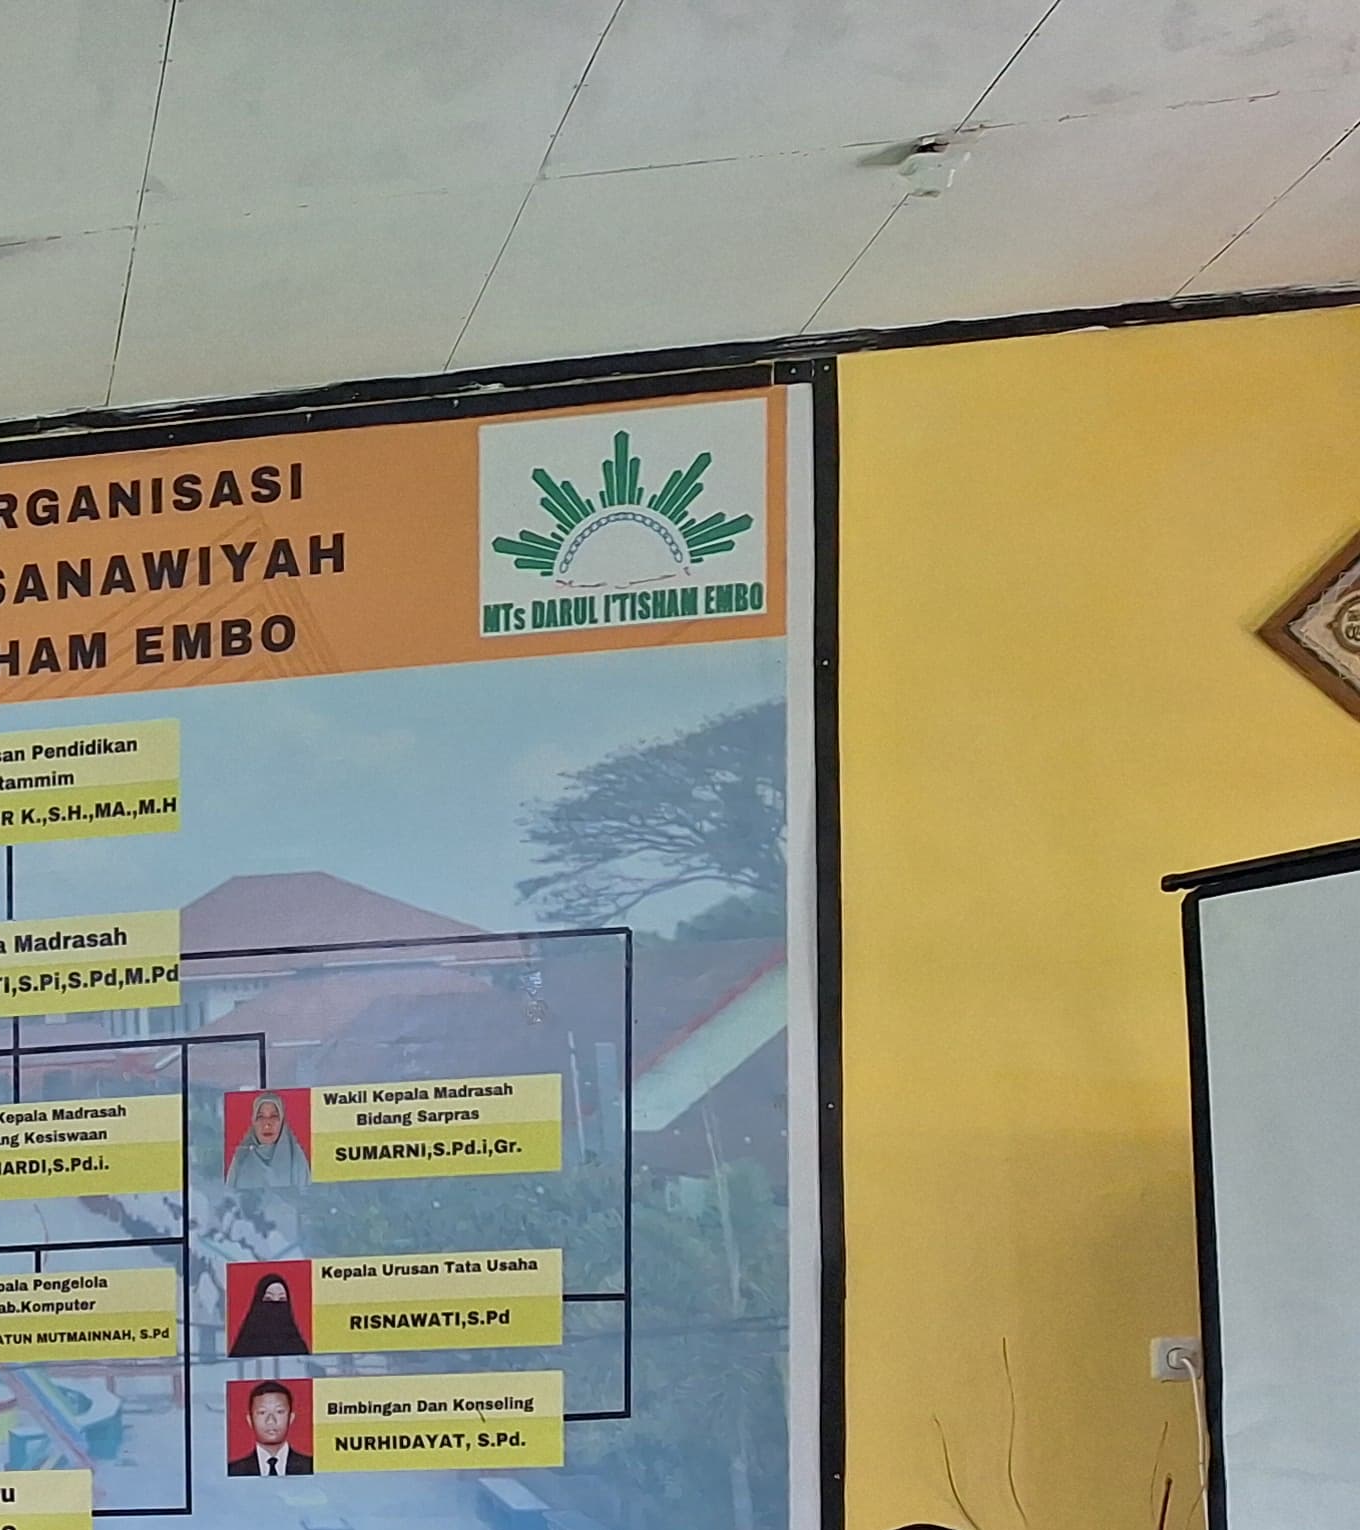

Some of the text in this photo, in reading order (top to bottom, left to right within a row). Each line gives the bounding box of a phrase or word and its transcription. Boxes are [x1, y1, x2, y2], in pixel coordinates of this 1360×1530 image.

[483, 581, 765, 633] MTs DARUL I'TISHAM EMBO
[135, 614, 296, 665] EMBO
[31, 738, 138, 760] Pendidikan
[14, 926, 127, 954] Madrasah
[323, 1082, 514, 1106] Wakil Kepala Madrasah
[51, 1104, 127, 1121] Madrasah
[356, 1109, 480, 1127] Bidang Sarpras
[24, 1129, 108, 1145] Kesiswaan
[321, 1257, 538, 1281] Kepala Urusan Tata Usaha
[33, 1275, 108, 1293] Pengelola
[349, 1308, 510, 1331] RISNAWATI,S.Pd
[36, 1329, 136, 1344] MUTMAINNAH,
[139, 1327, 170, 1340] S.Pd
[327, 1396, 534, 1417] Bimbingan Dan Konseling
[335, 1431, 526, 1452] NURHIDAYAT, S.Pd.
